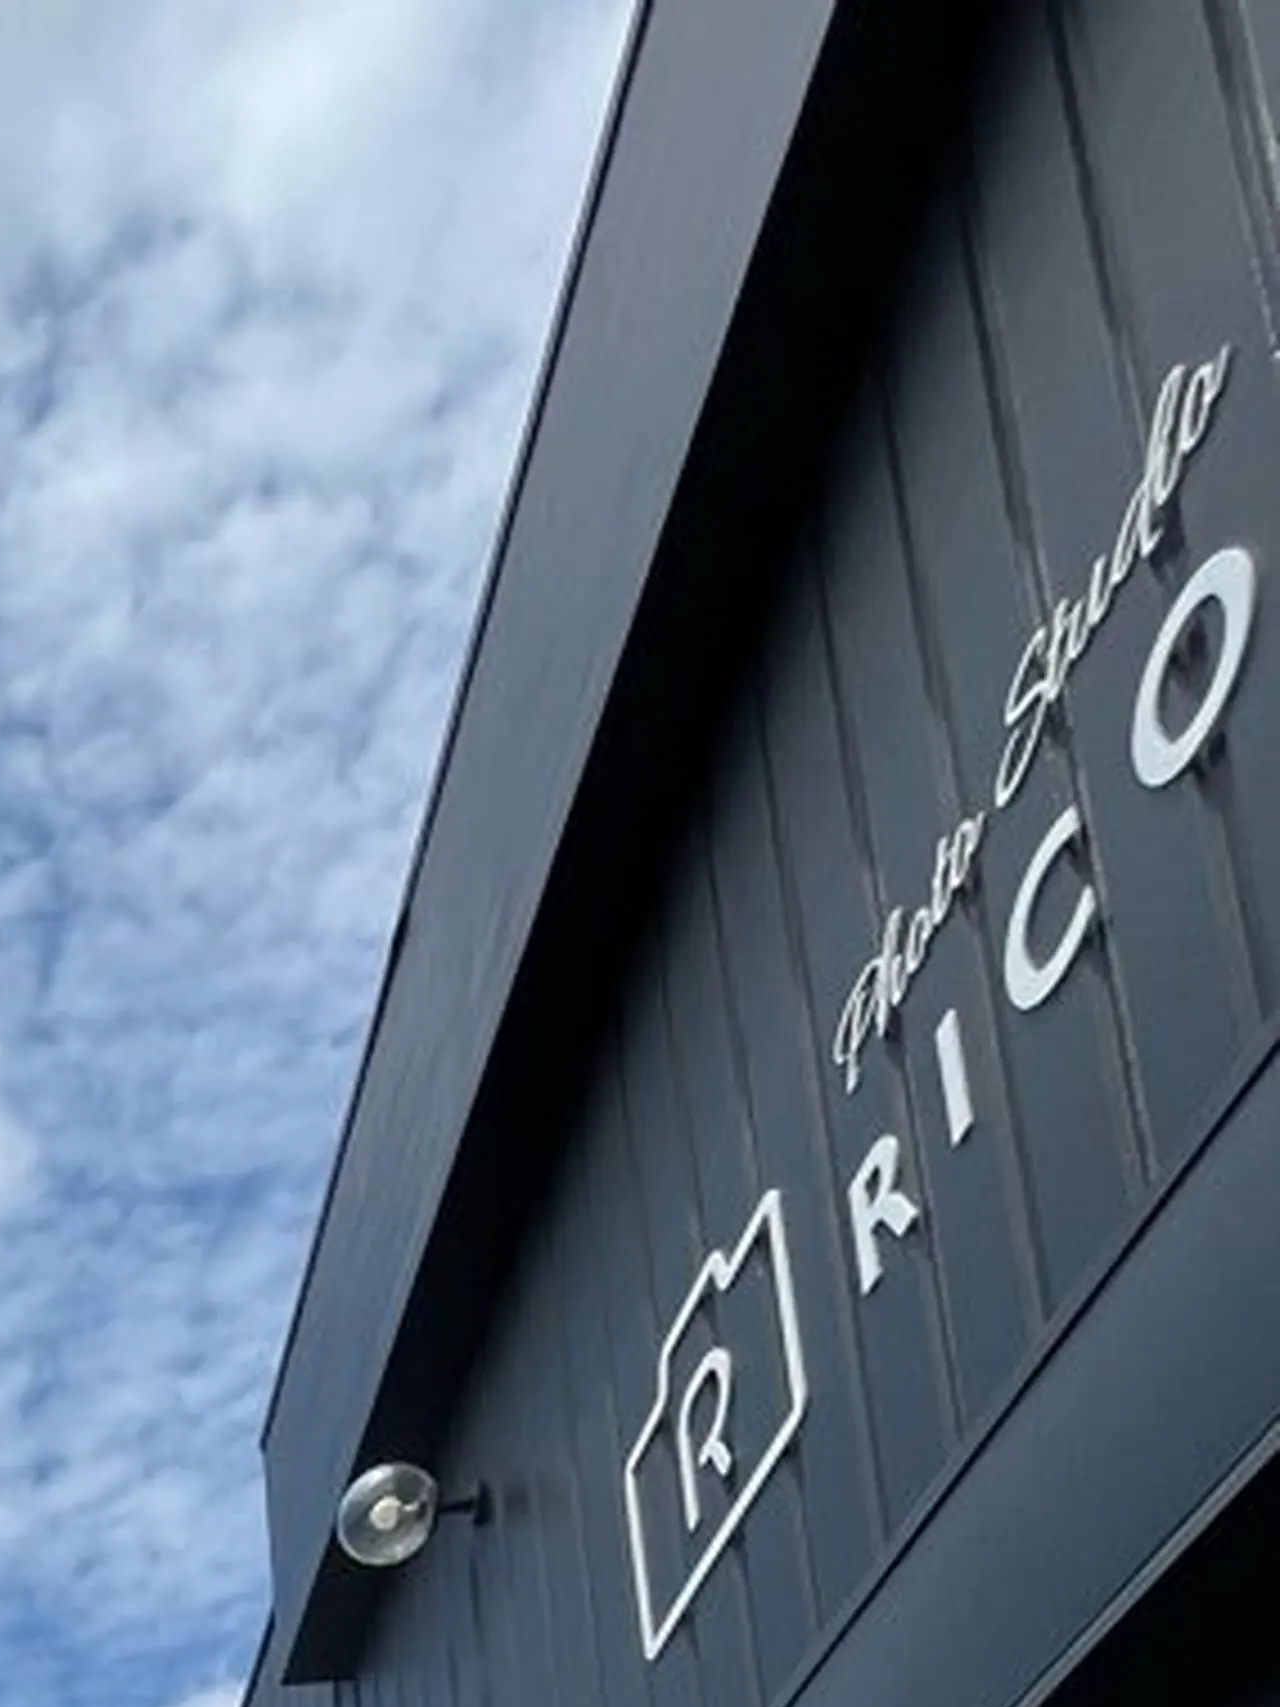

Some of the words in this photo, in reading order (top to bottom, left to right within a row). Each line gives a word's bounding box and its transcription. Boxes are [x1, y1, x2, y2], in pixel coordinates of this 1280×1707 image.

[833, 811, 987, 1095] Photo
[996, 341, 1232, 808] Studio
[845, 547, 1256, 1294] RICO
[679, 1347, 732, 1532] R
